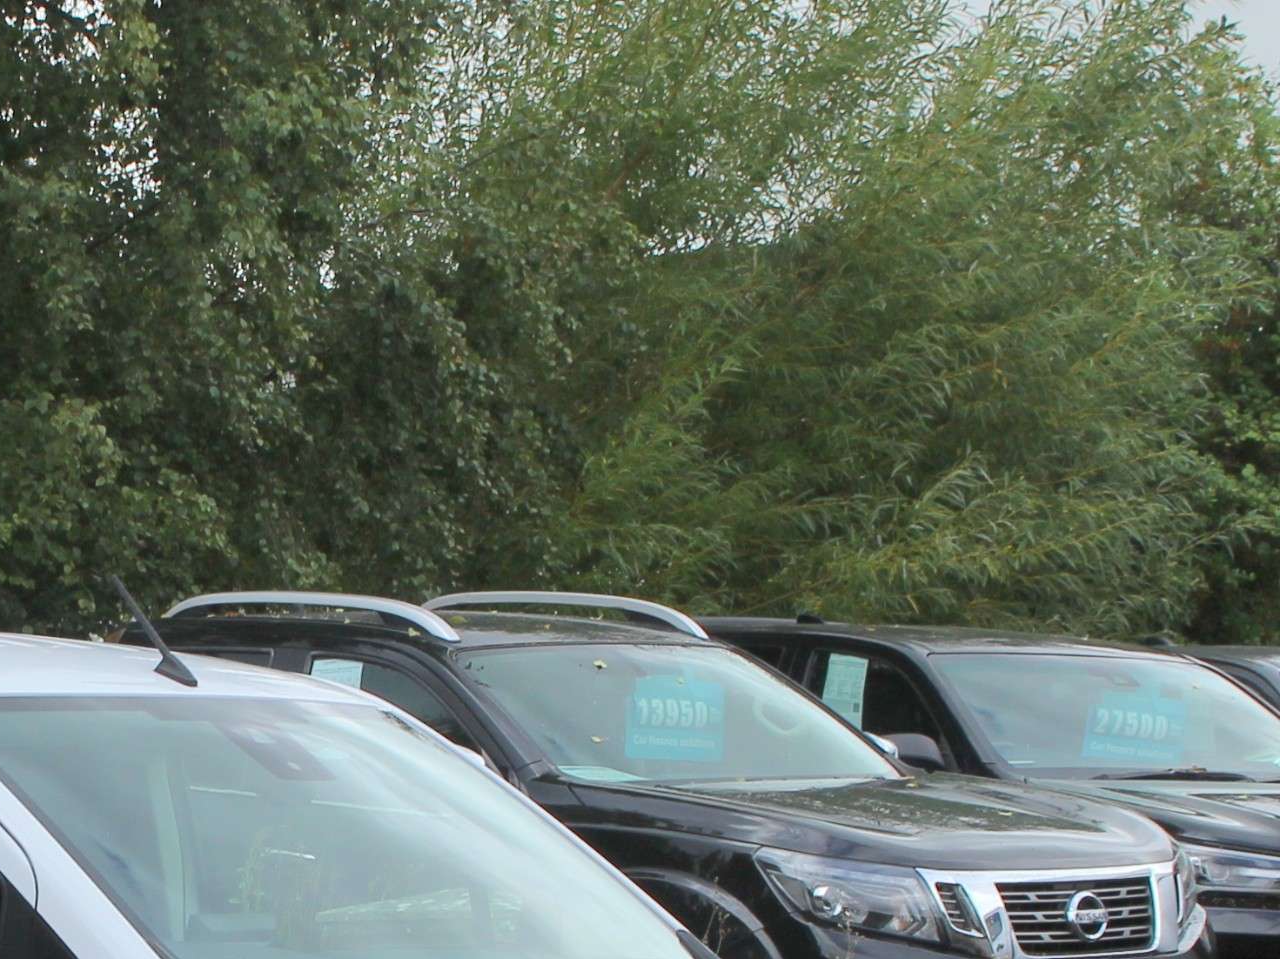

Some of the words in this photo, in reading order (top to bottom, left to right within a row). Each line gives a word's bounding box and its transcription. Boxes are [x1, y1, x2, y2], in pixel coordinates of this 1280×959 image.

[638, 698, 709, 728] 13950
[1092, 708, 1169, 740] 27500
[1075, 911, 1108, 921] NISSAN
